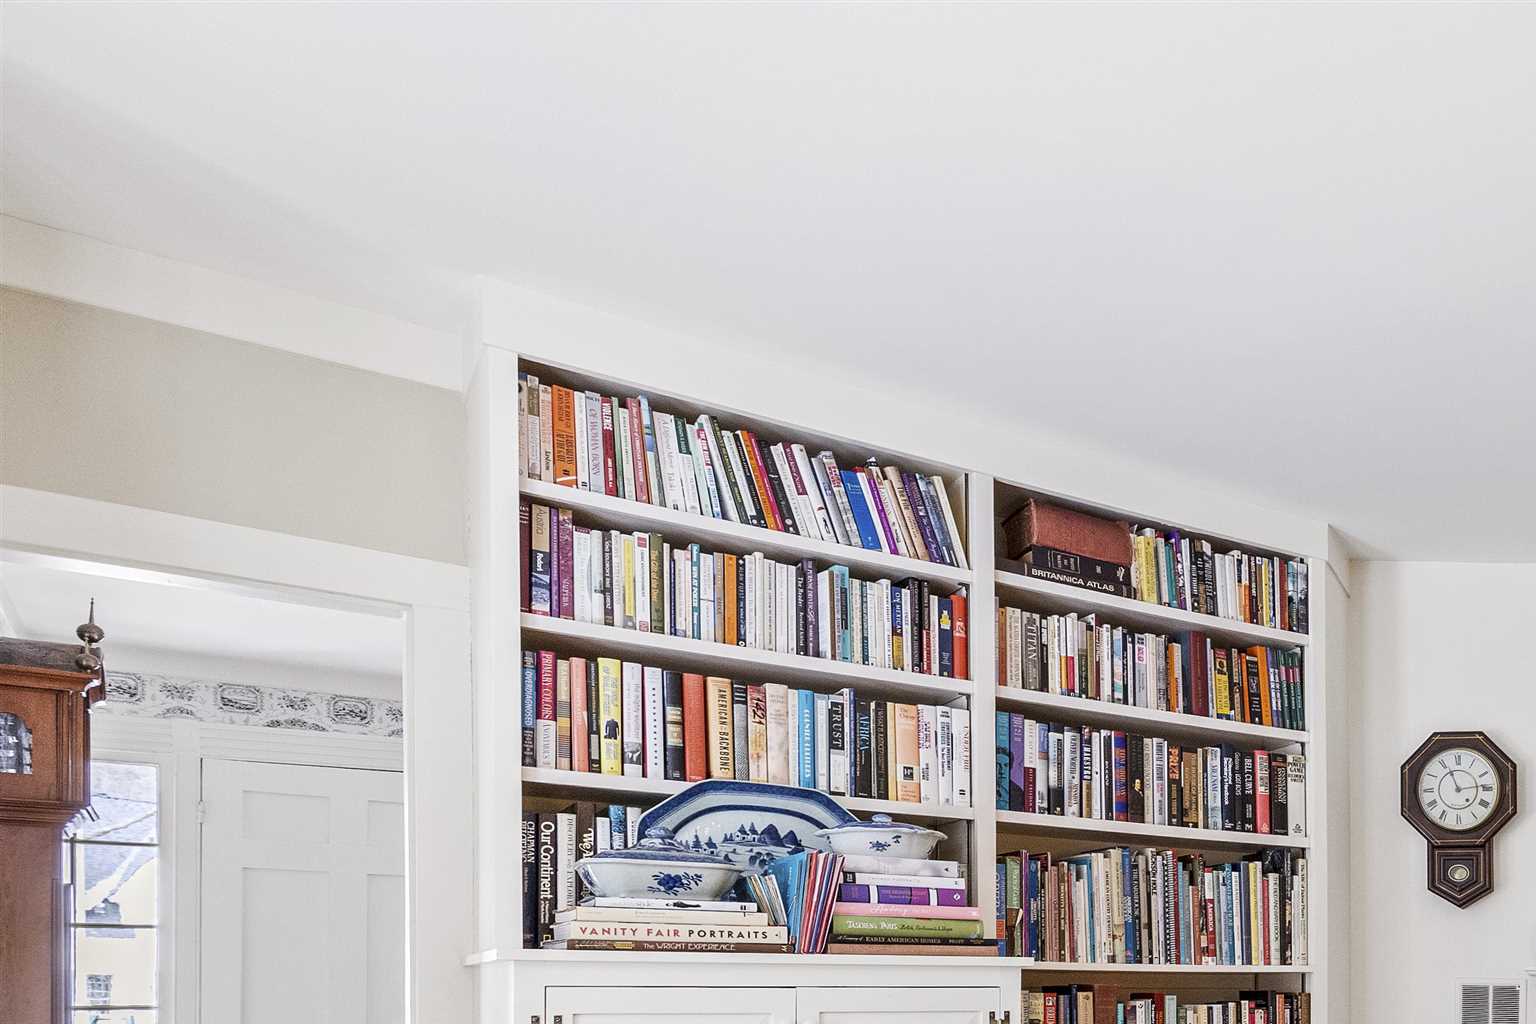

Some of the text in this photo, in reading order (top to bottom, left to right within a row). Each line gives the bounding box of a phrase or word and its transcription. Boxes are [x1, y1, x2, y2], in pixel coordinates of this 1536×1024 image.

[602, 402, 613, 431] VIOLENCE
[589, 421, 599, 451] WOMAN
[591, 453, 600, 476] BORN
[536, 508, 545, 535] Austria
[1031, 568, 1114, 592] BRITANNICA ATLAS
[894, 592, 901, 602] ON
[1027, 625, 1037, 659] TITAN
[524, 671, 534, 726] OVERDIAGNOSED
[542, 654, 552, 719] PRIMARY COLORS
[751, 697, 764, 725] 1421
[718, 689, 730, 771] AMERICAN BACKBONE
[831, 706, 842, 747] TRUST
[859, 714, 870, 751] AFRICA
[1169, 748, 1178, 779] PRIZE
[527, 821, 535, 863] CHAPMAN
[540, 821, 555, 899] Our Continent
[579, 927, 768, 939] VANITY FAIR PORTRAITS
[688, 943, 735, 951] EXPERIENCE
